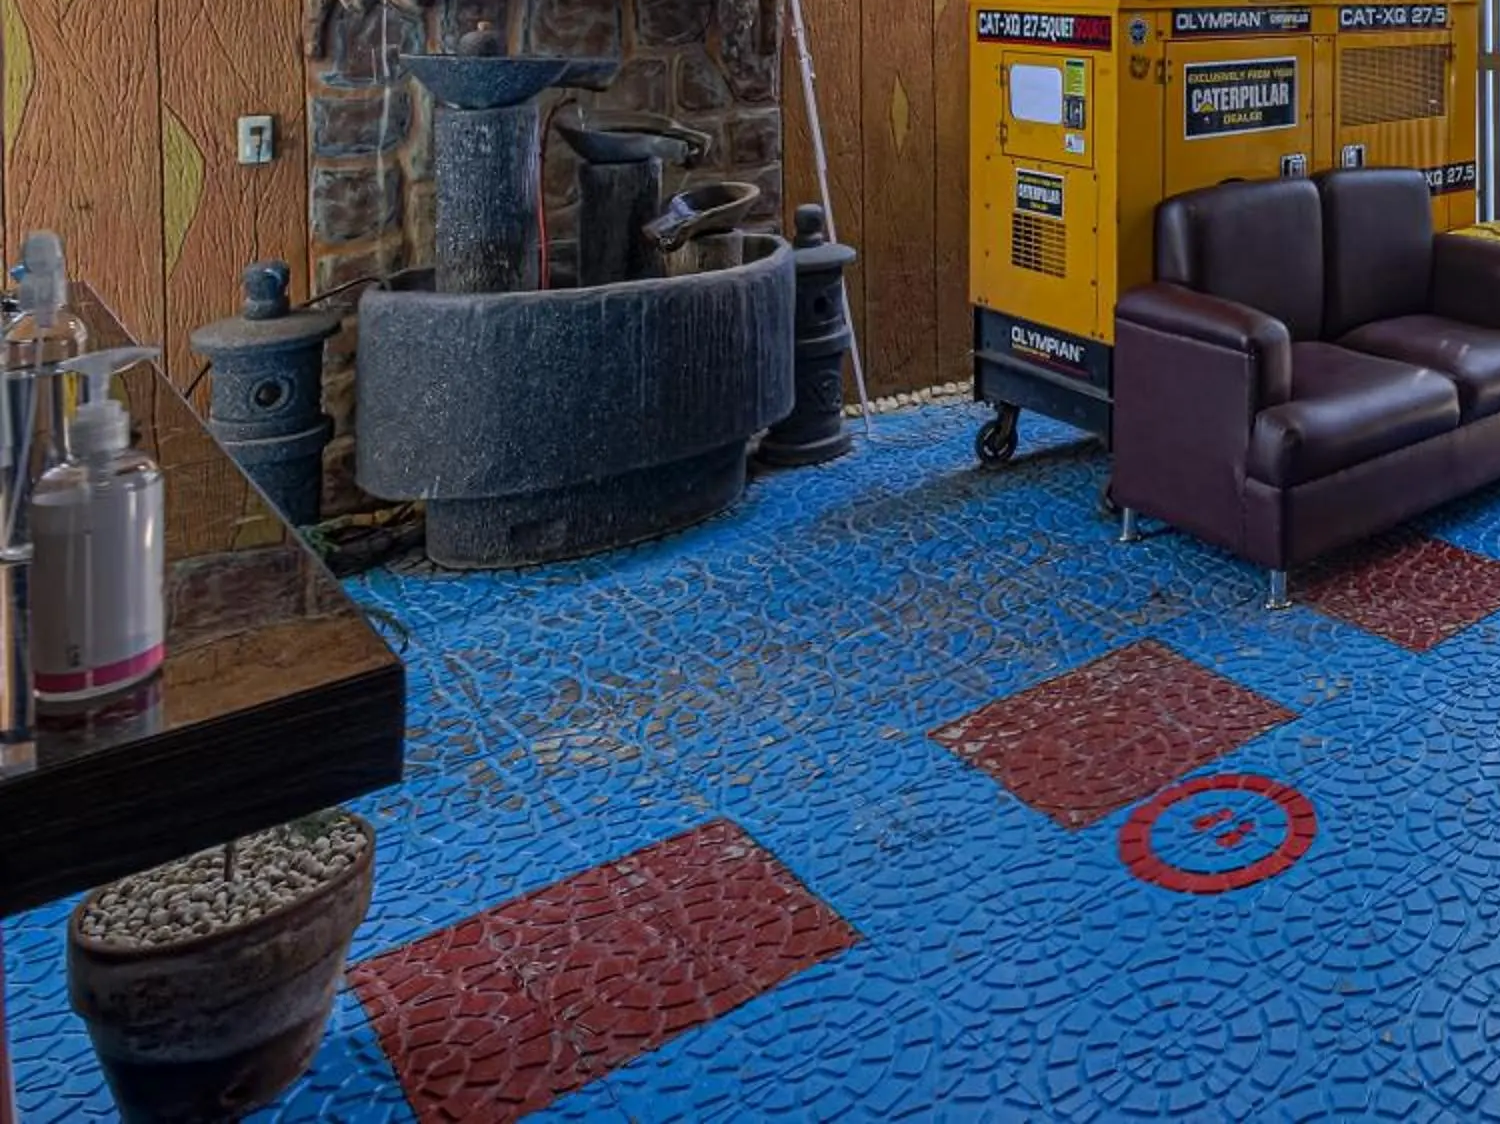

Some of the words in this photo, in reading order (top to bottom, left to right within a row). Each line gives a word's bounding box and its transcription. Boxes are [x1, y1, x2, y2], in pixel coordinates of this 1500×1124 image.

[1175, 11, 1261, 30] OLYMPIAN
[1341, 7, 1406, 26] CAT-XQ
[1411, 6, 1446, 24] 27.5
[1191, 82, 1290, 114] CATERPILLAR
[1223, 111, 1262, 124] DEALER
[1447, 165, 1475, 183] 27.5
[1011, 325, 1081, 364] OLYMPIAN
